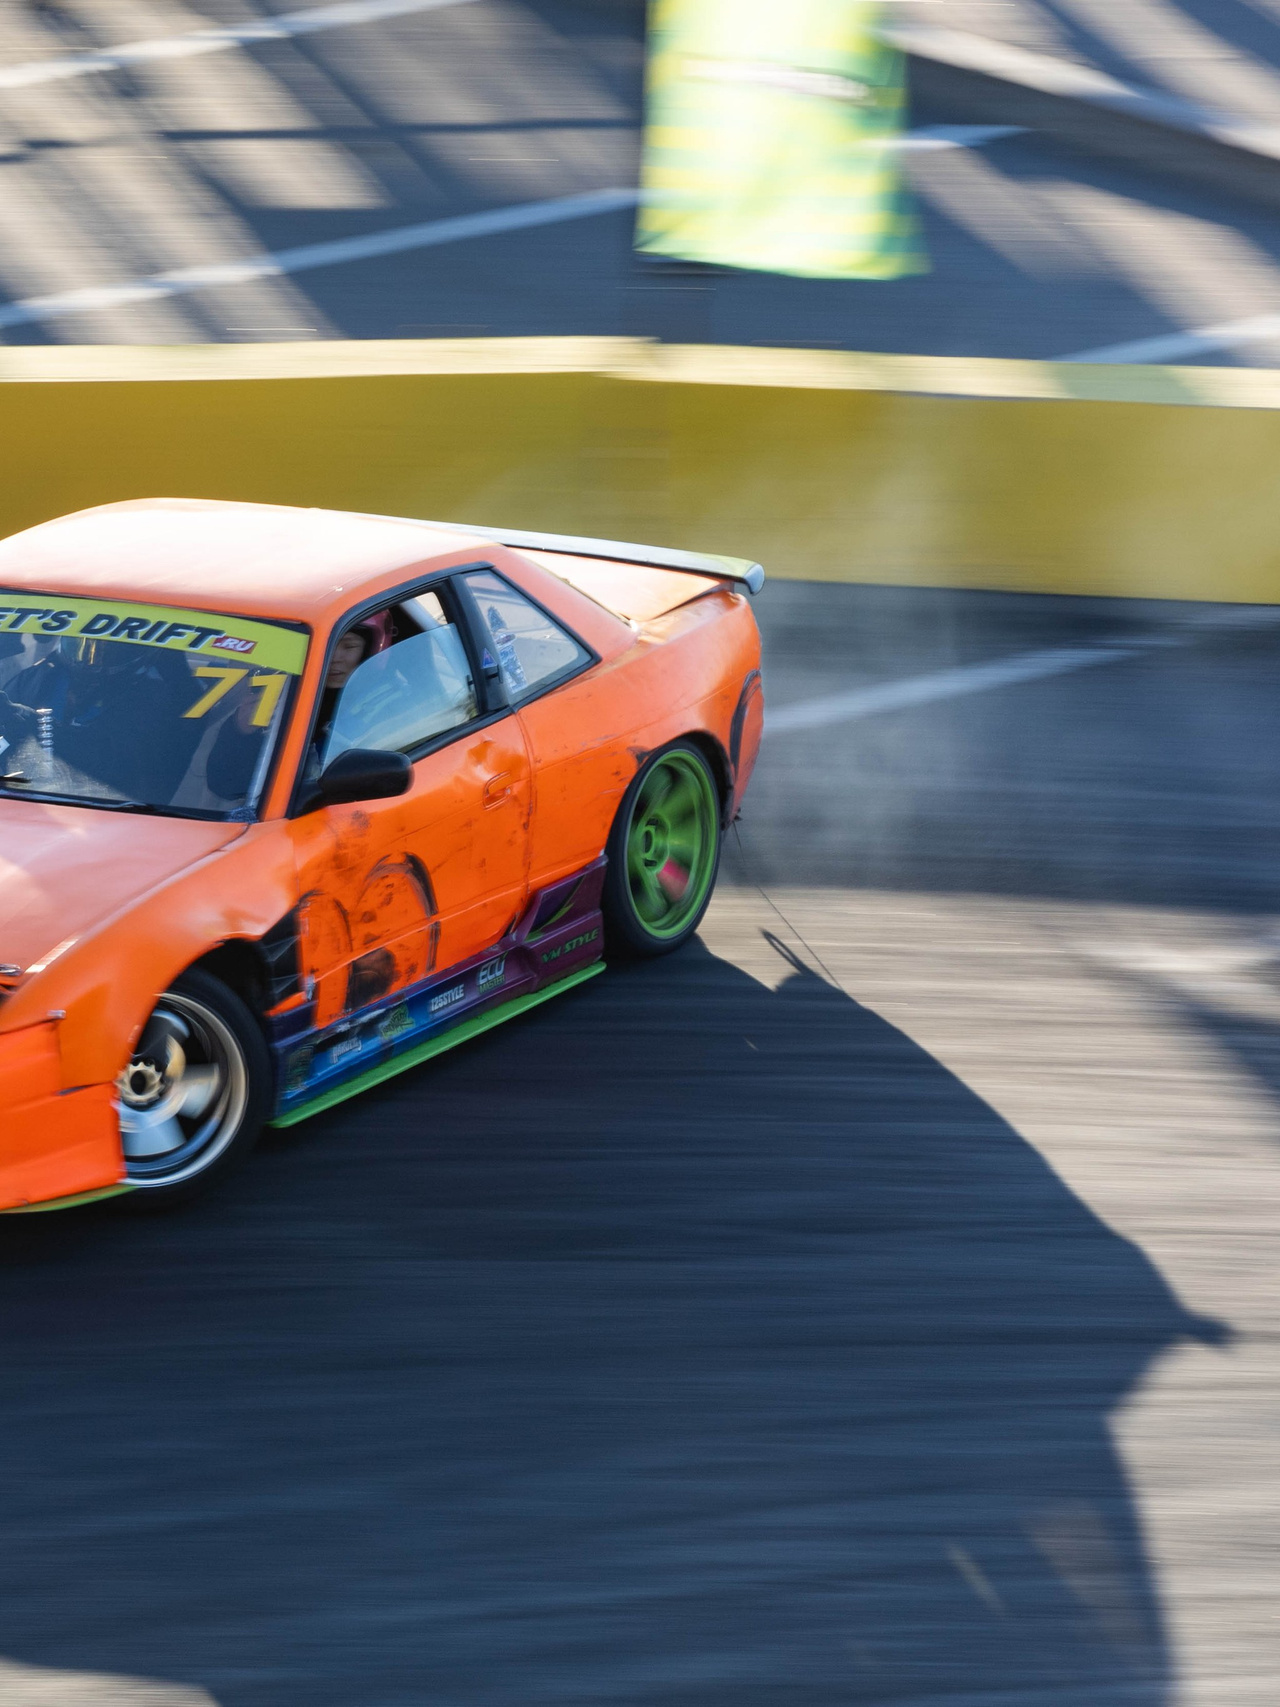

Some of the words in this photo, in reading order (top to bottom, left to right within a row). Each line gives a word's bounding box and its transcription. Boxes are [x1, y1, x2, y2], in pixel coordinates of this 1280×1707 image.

[180, 666, 289, 728] 71
[564, 926, 601, 954] STYLE
[478, 957, 506, 985] ECU
